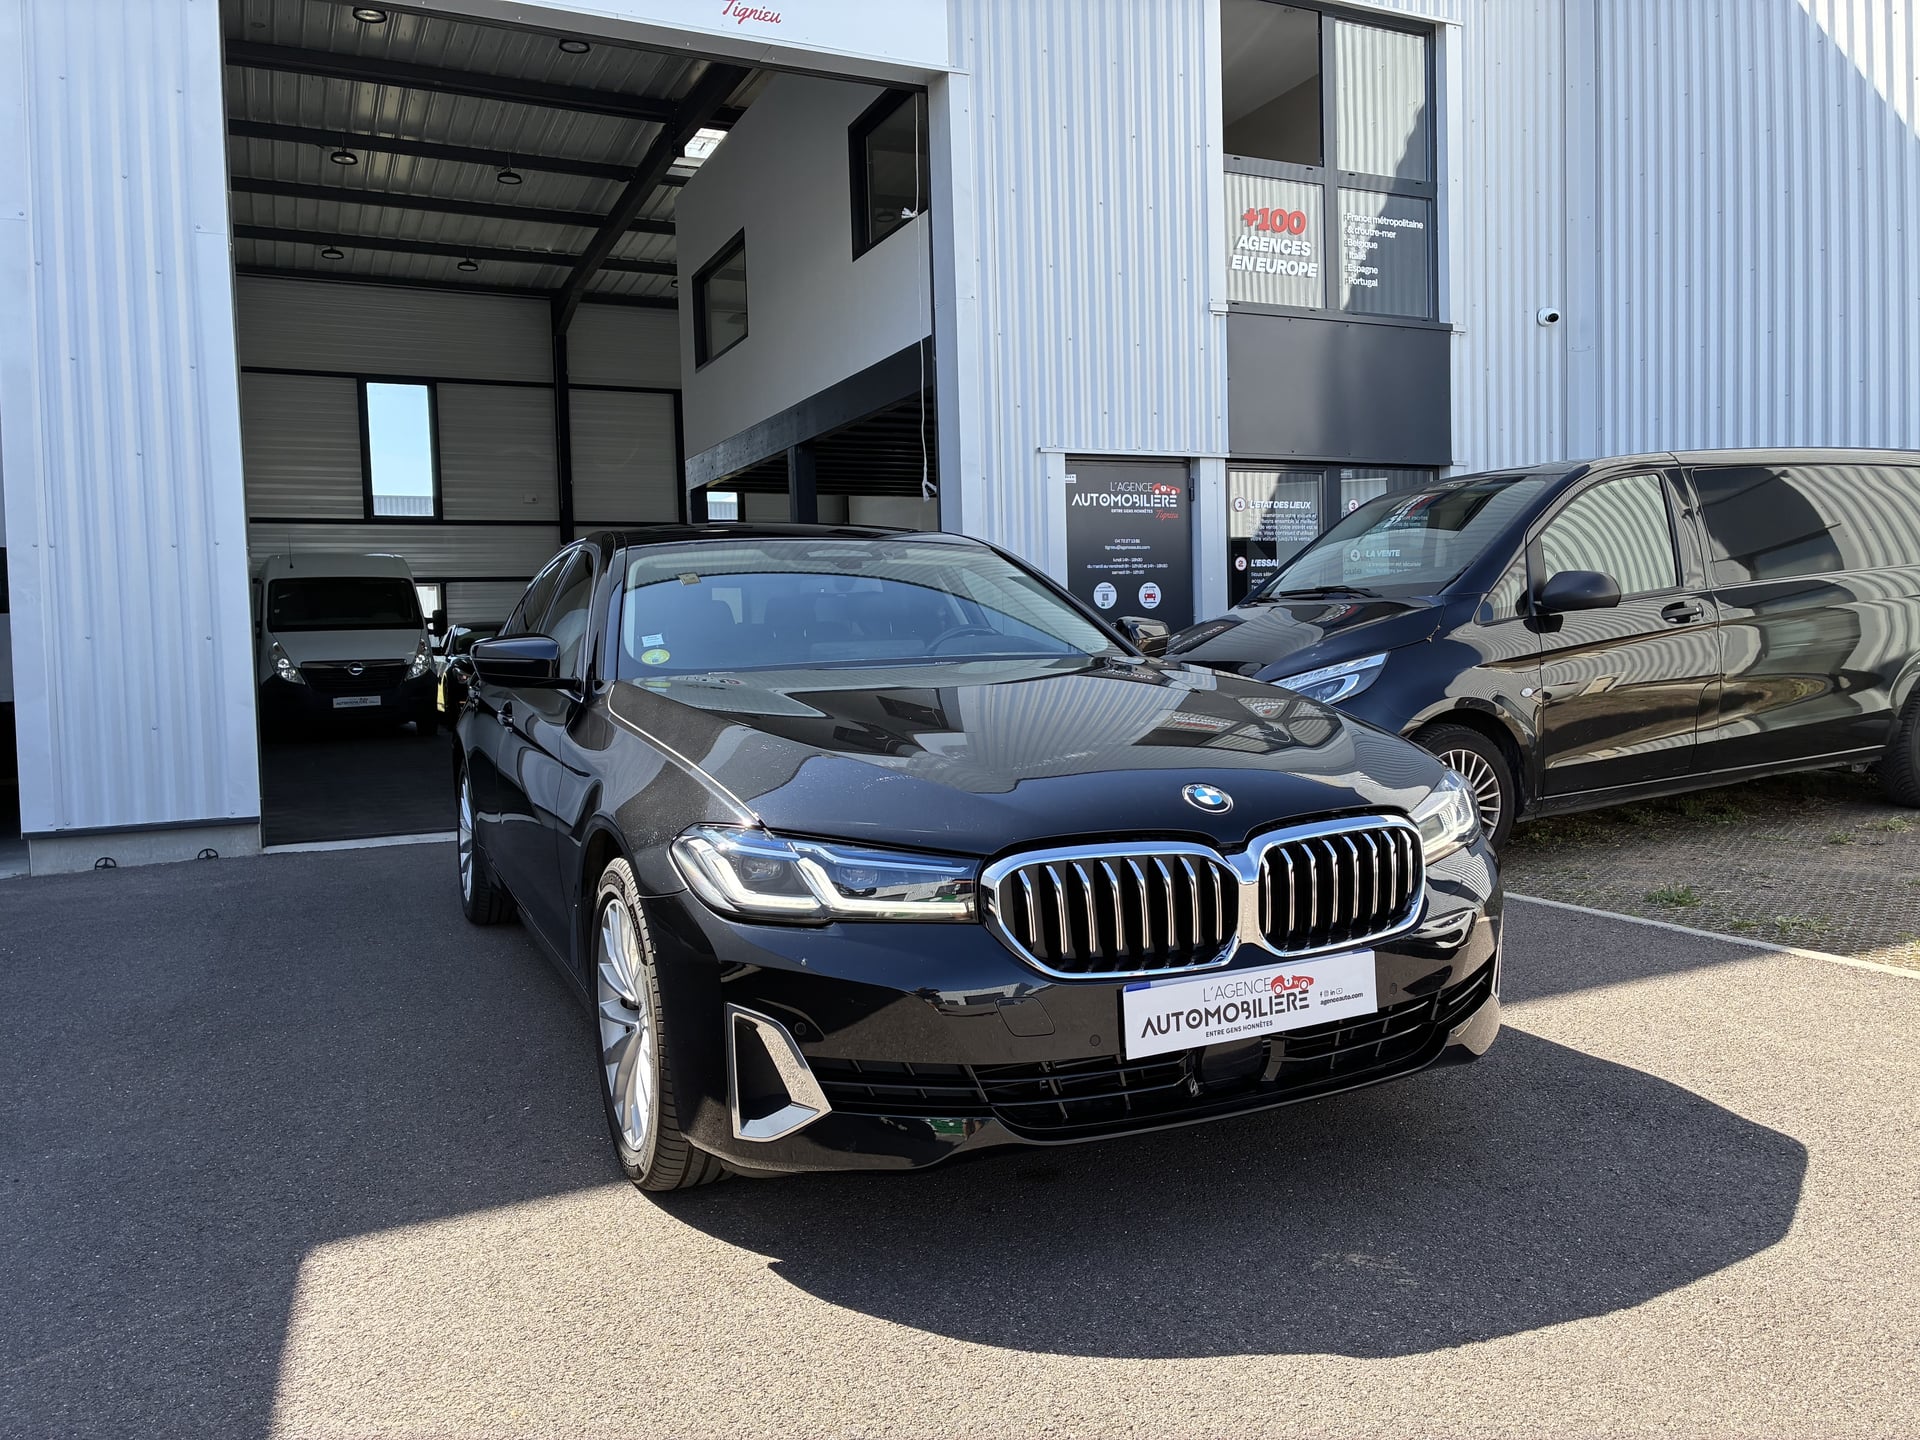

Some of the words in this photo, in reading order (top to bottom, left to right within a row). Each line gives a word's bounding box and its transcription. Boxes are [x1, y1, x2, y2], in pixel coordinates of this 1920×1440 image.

[722, 0, 782, 25] Tignieu
[1243, 207, 1307, 236] +100
[1346, 212, 1372, 224] France
[1372, 215, 1425, 230] métropolitaine
[1354, 226, 1397, 239] d'outre-mer
[1236, 234, 1312, 257] AGENCES
[1347, 238, 1379, 250] Belgique
[1231, 254, 1255, 271] EN
[1255, 257, 1319, 278] EUROPE
[1347, 263, 1379, 275] Espagne
[1348, 276, 1379, 288] Portugal
[1110, 482, 1153, 492] L'AGENCE
[1273, 501, 1289, 509] DES
[1289, 501, 1312, 510] LIEUX
[1376, 549, 1400, 557] VENTE
[1203, 976, 1272, 1003] L'AGENCE
[1205, 1028, 1225, 1038] ENTRE
[1225, 1026, 1242, 1035] GENS
[1243, 1019, 1273, 1032] HONNÊTES
